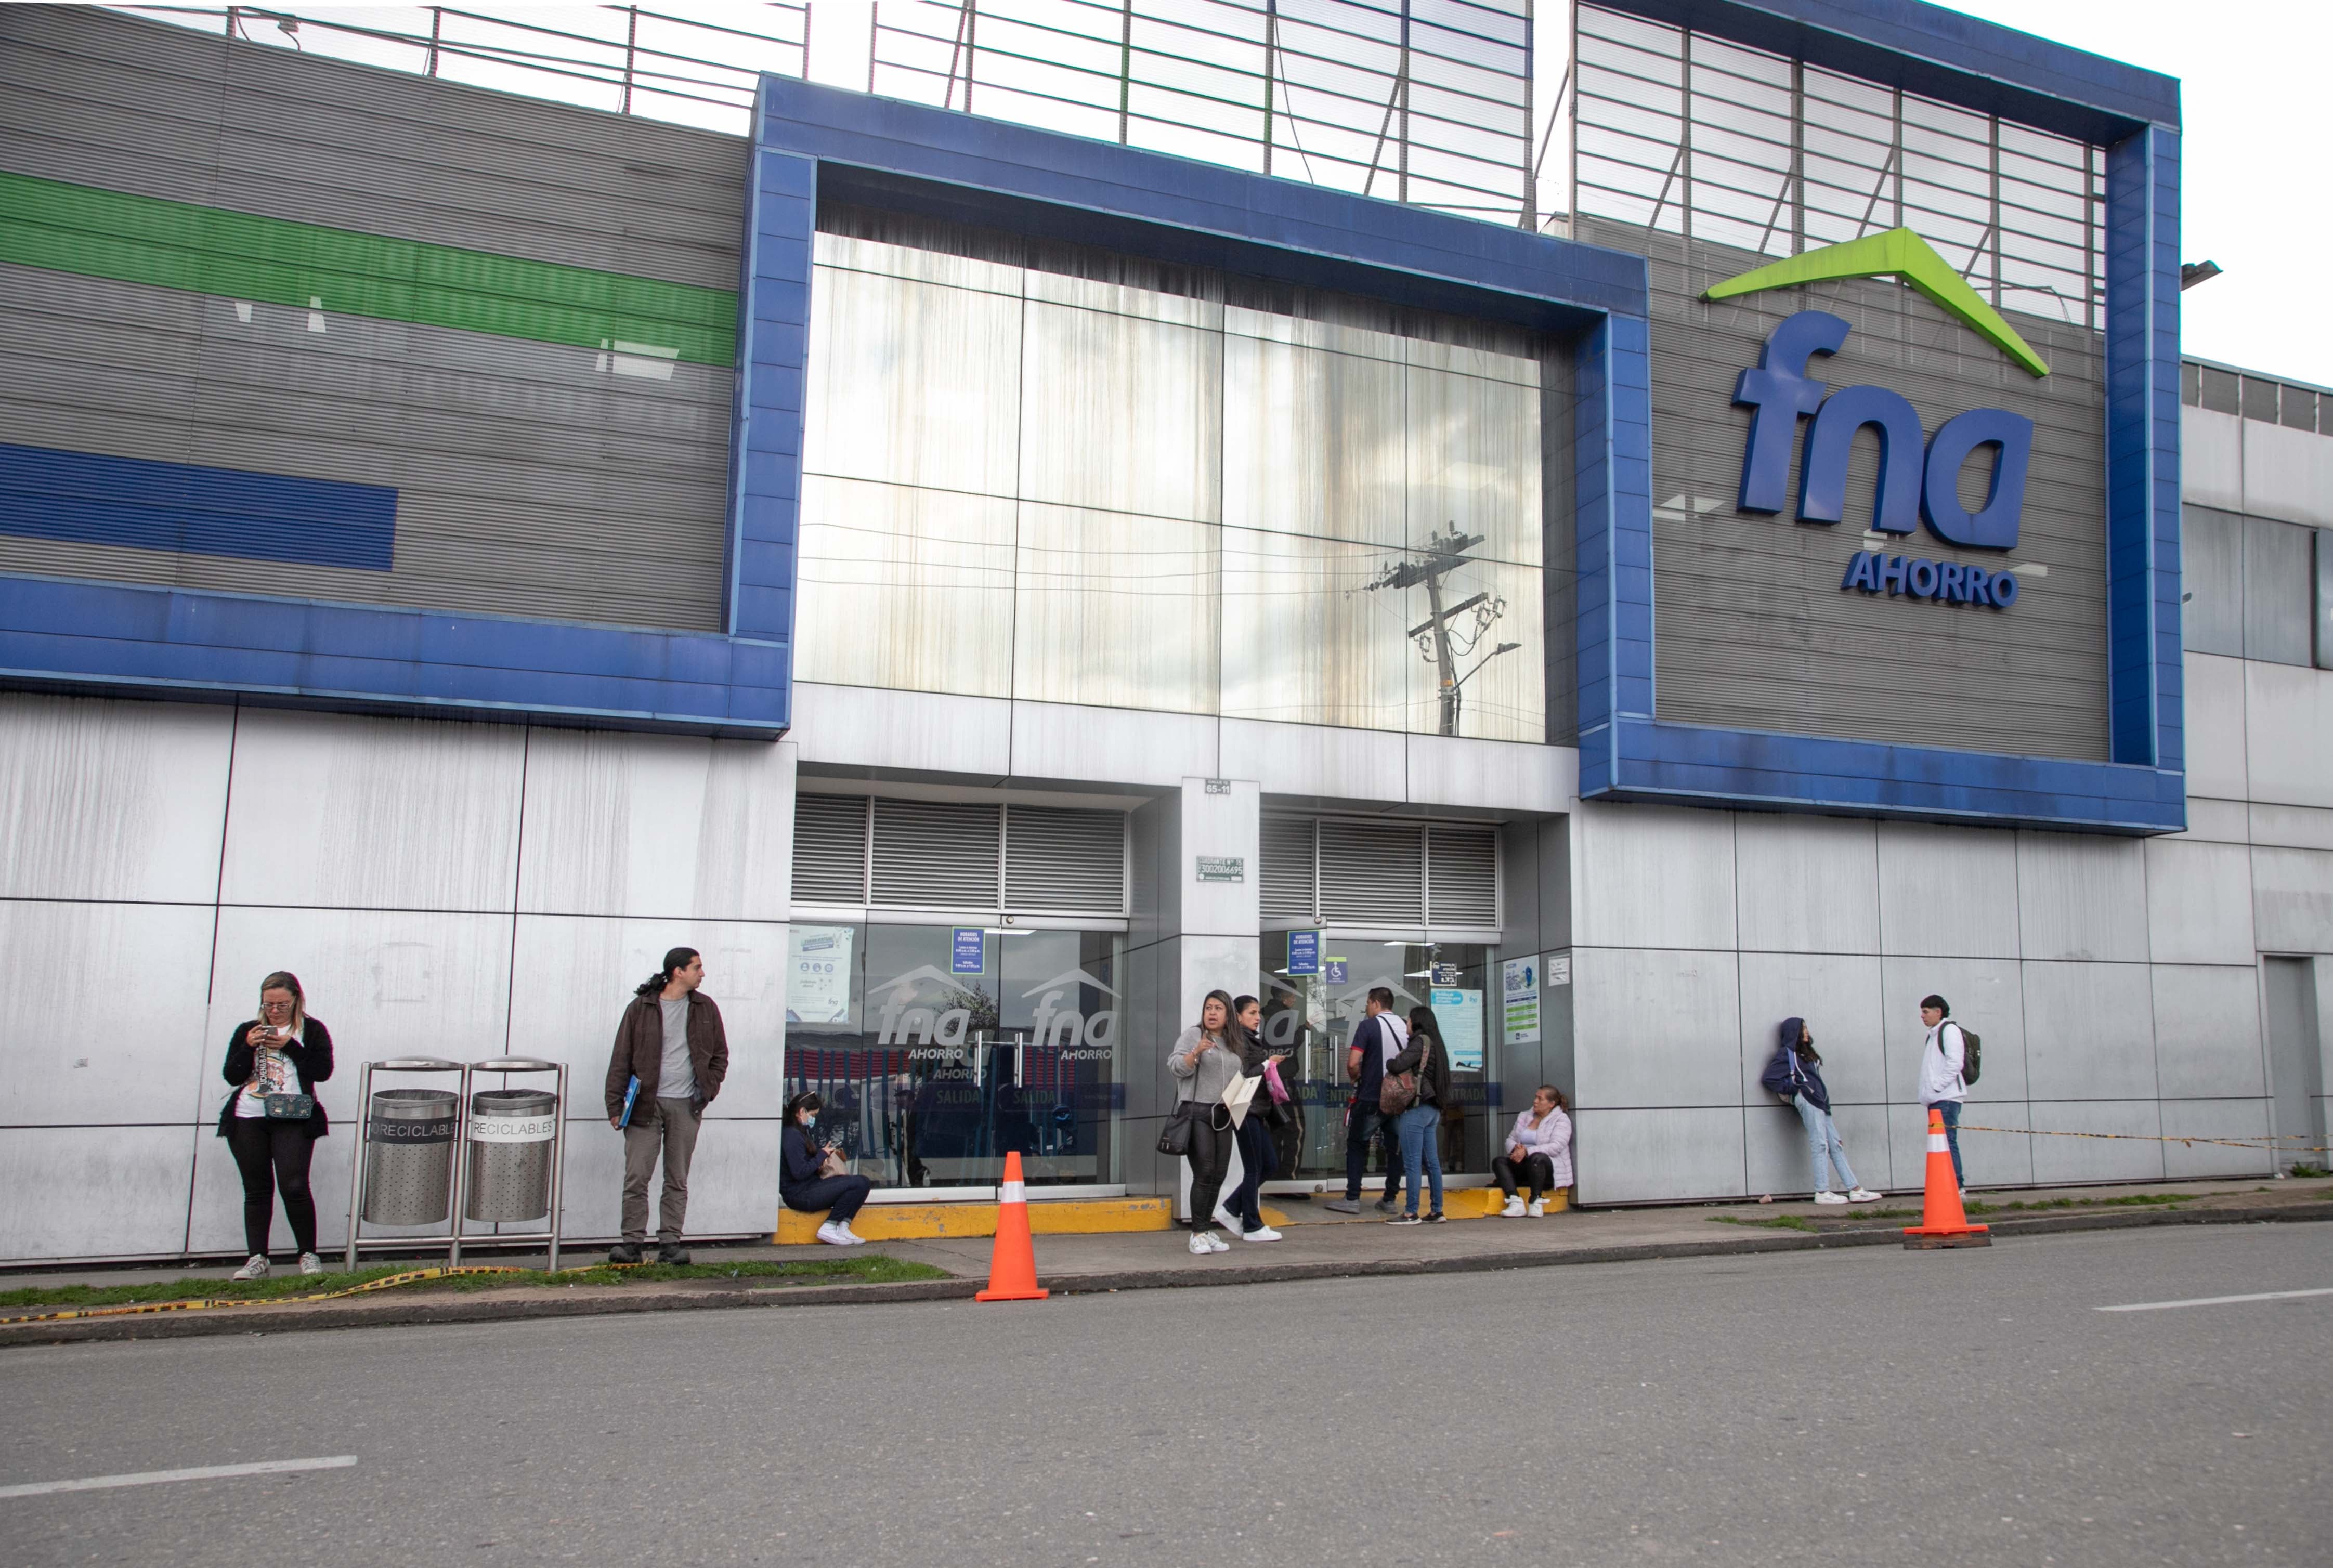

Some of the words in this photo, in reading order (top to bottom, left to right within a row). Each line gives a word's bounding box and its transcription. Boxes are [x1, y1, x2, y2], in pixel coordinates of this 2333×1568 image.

[1731, 309, 2034, 551] fna
[1841, 551, 2018, 609] AHORRO
[1206, 785, 1229, 793] 65-11
[1202, 865, 1243, 874] 3002006695
[878, 987, 971, 1046] fna
[1032, 990, 1118, 1047] fna
[908, 1049, 963, 1059] AHORRO
[1061, 1050, 1112, 1060] AHORRO
[937, 1090, 980, 1104] SALIDA
[1014, 1090, 1055, 1104] SALIDA
[1448, 1088, 1486, 1100] NTRADA
[474, 1121, 552, 1135] RECICLABLES
